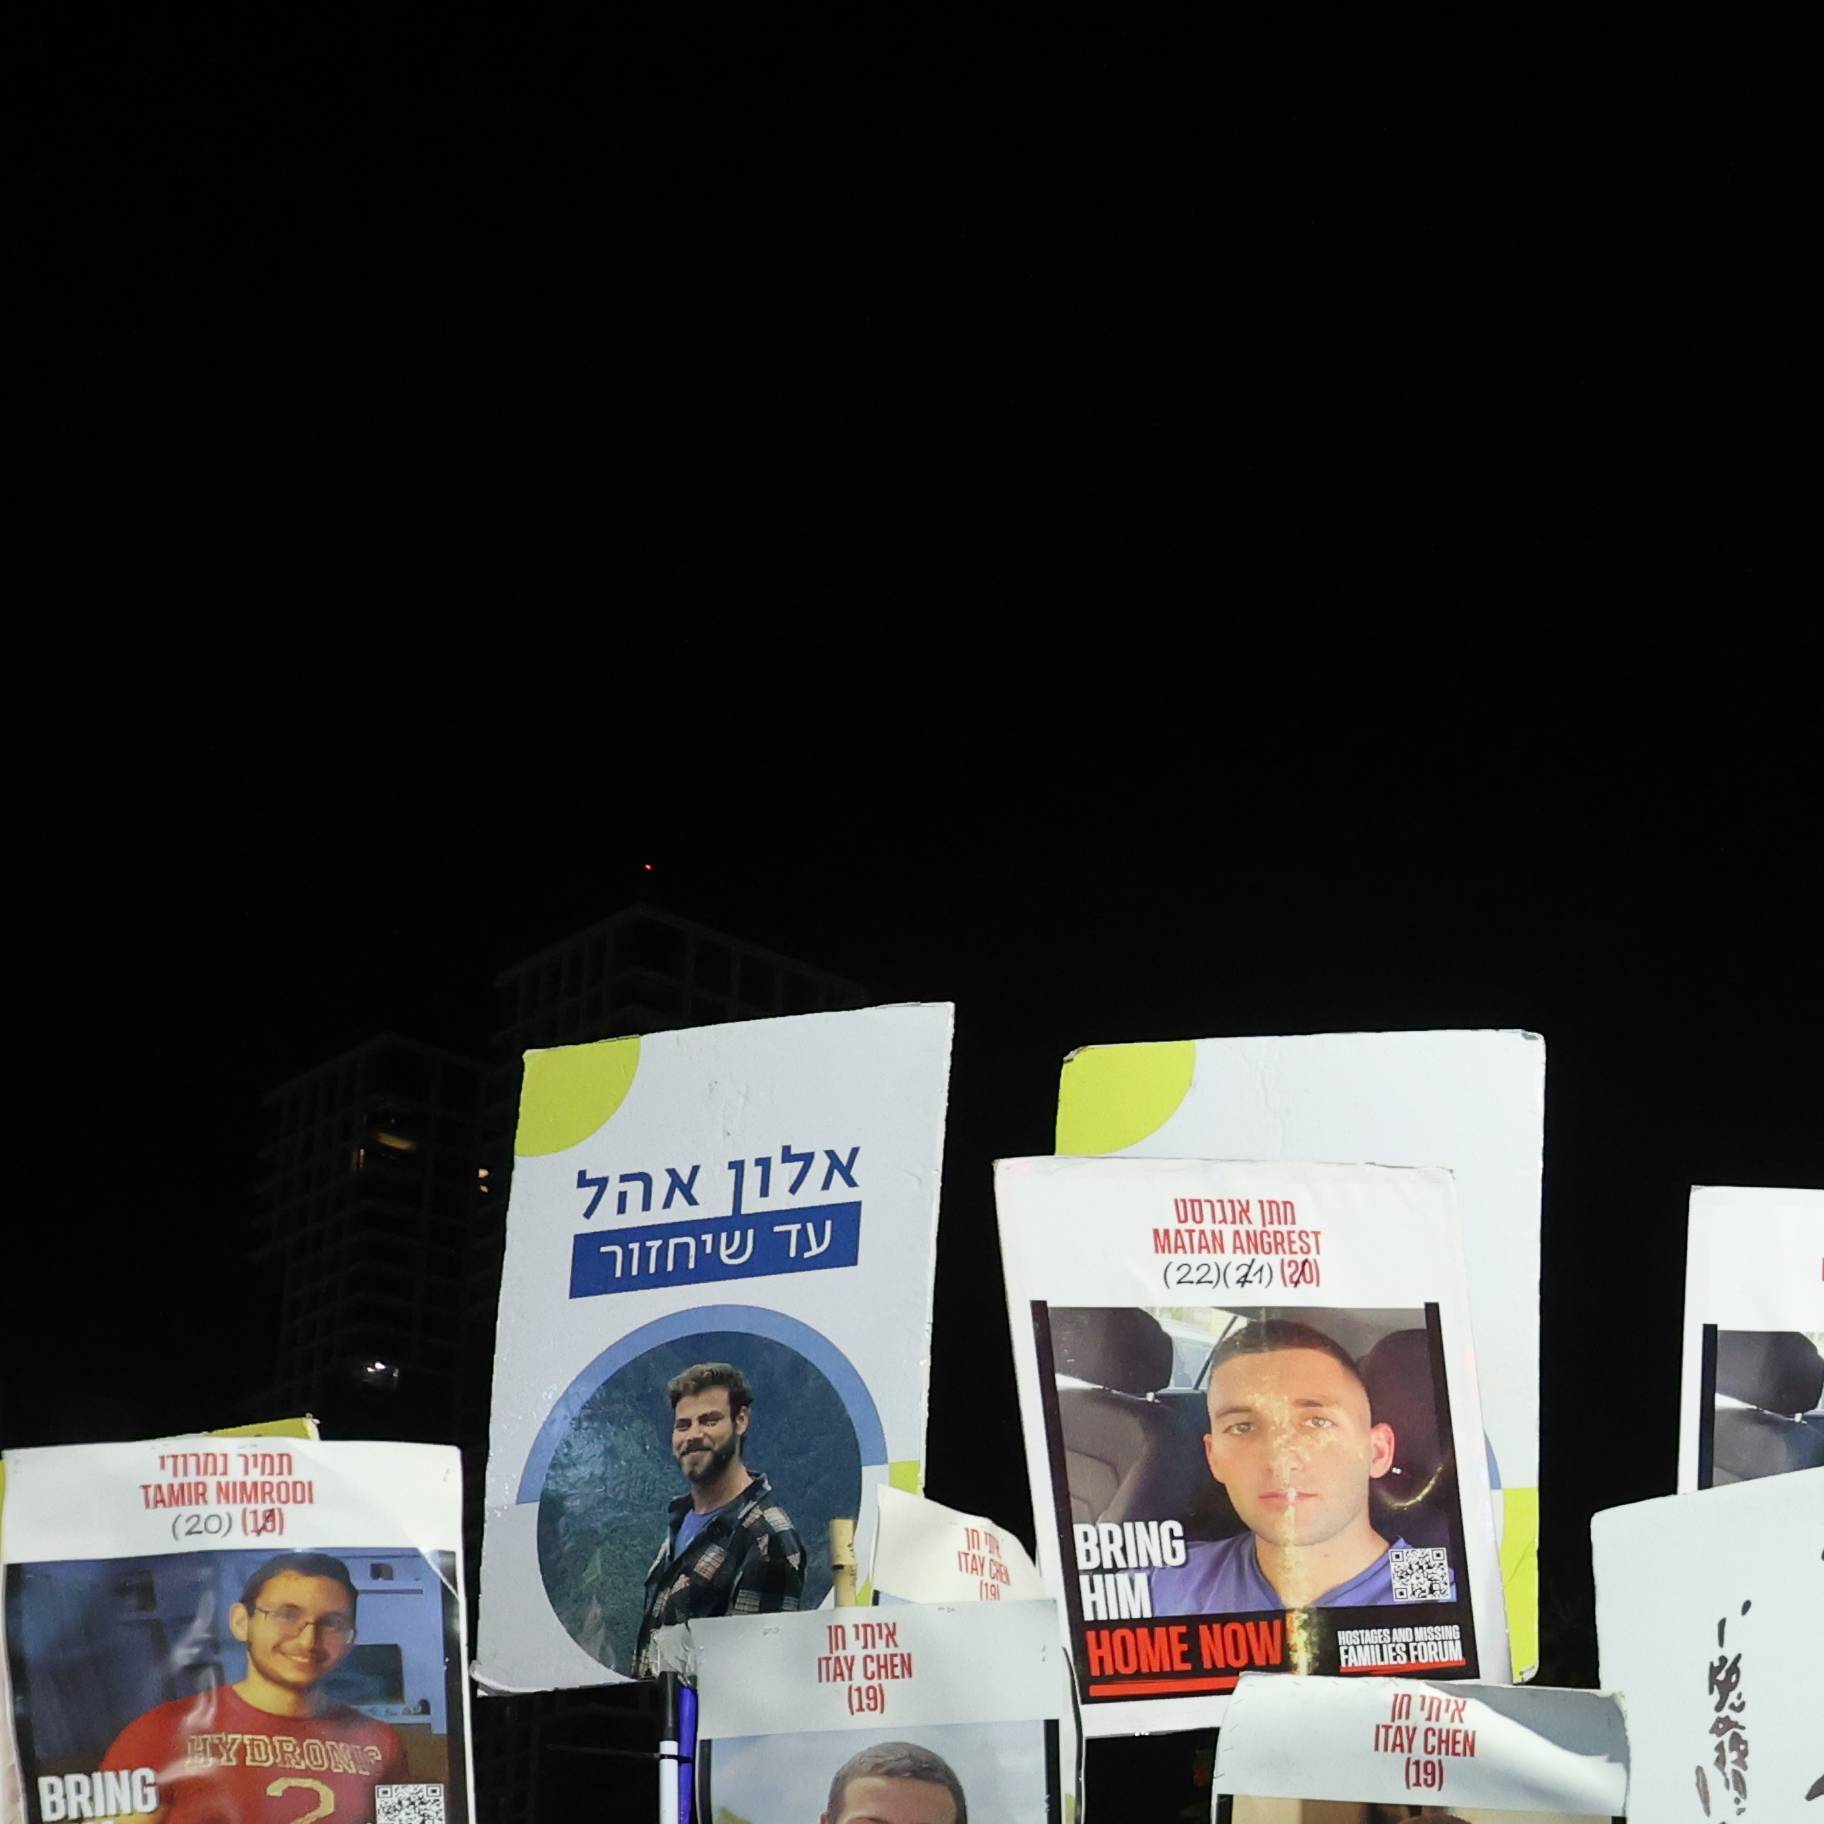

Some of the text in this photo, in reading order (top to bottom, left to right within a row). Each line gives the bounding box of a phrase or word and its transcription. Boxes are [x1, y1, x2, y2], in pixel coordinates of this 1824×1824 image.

[577, 1145, 861, 1221] אלון אהל
[1173, 1197, 1296, 1227] מתן אנגרסט
[599, 1219, 833, 1281] עד שיחזור
[1153, 1229, 1321, 1255] MATAN ANGREST
[159, 1452, 292, 1477] תמיר נמרודי
[139, 1480, 314, 1509] TAMIR NIMRODI
[171, 1512, 233, 1541] (20)
[1073, 1519, 1187, 1573] BRING
[958, 1551, 985, 1577] ITAY
[1080, 1572, 1153, 1621] HIM
[827, 1622, 898, 1651] איתי חן
[1085, 1623, 1193, 1677] HOME
[1337, 1625, 1460, 1645] HOSTAGES AND MISSING
[817, 1652, 913, 1683] ITAY CHEN
[1340, 1640, 1463, 1667] FAMILIES FORUM
[848, 1684, 886, 1715] (19)
[1390, 1692, 1466, 1724] איתי חן
[1374, 1725, 1476, 1758] ITAY CHEN
[1405, 1759, 1444, 1791] (19)
[37, 1768, 157, 1822] BRING
